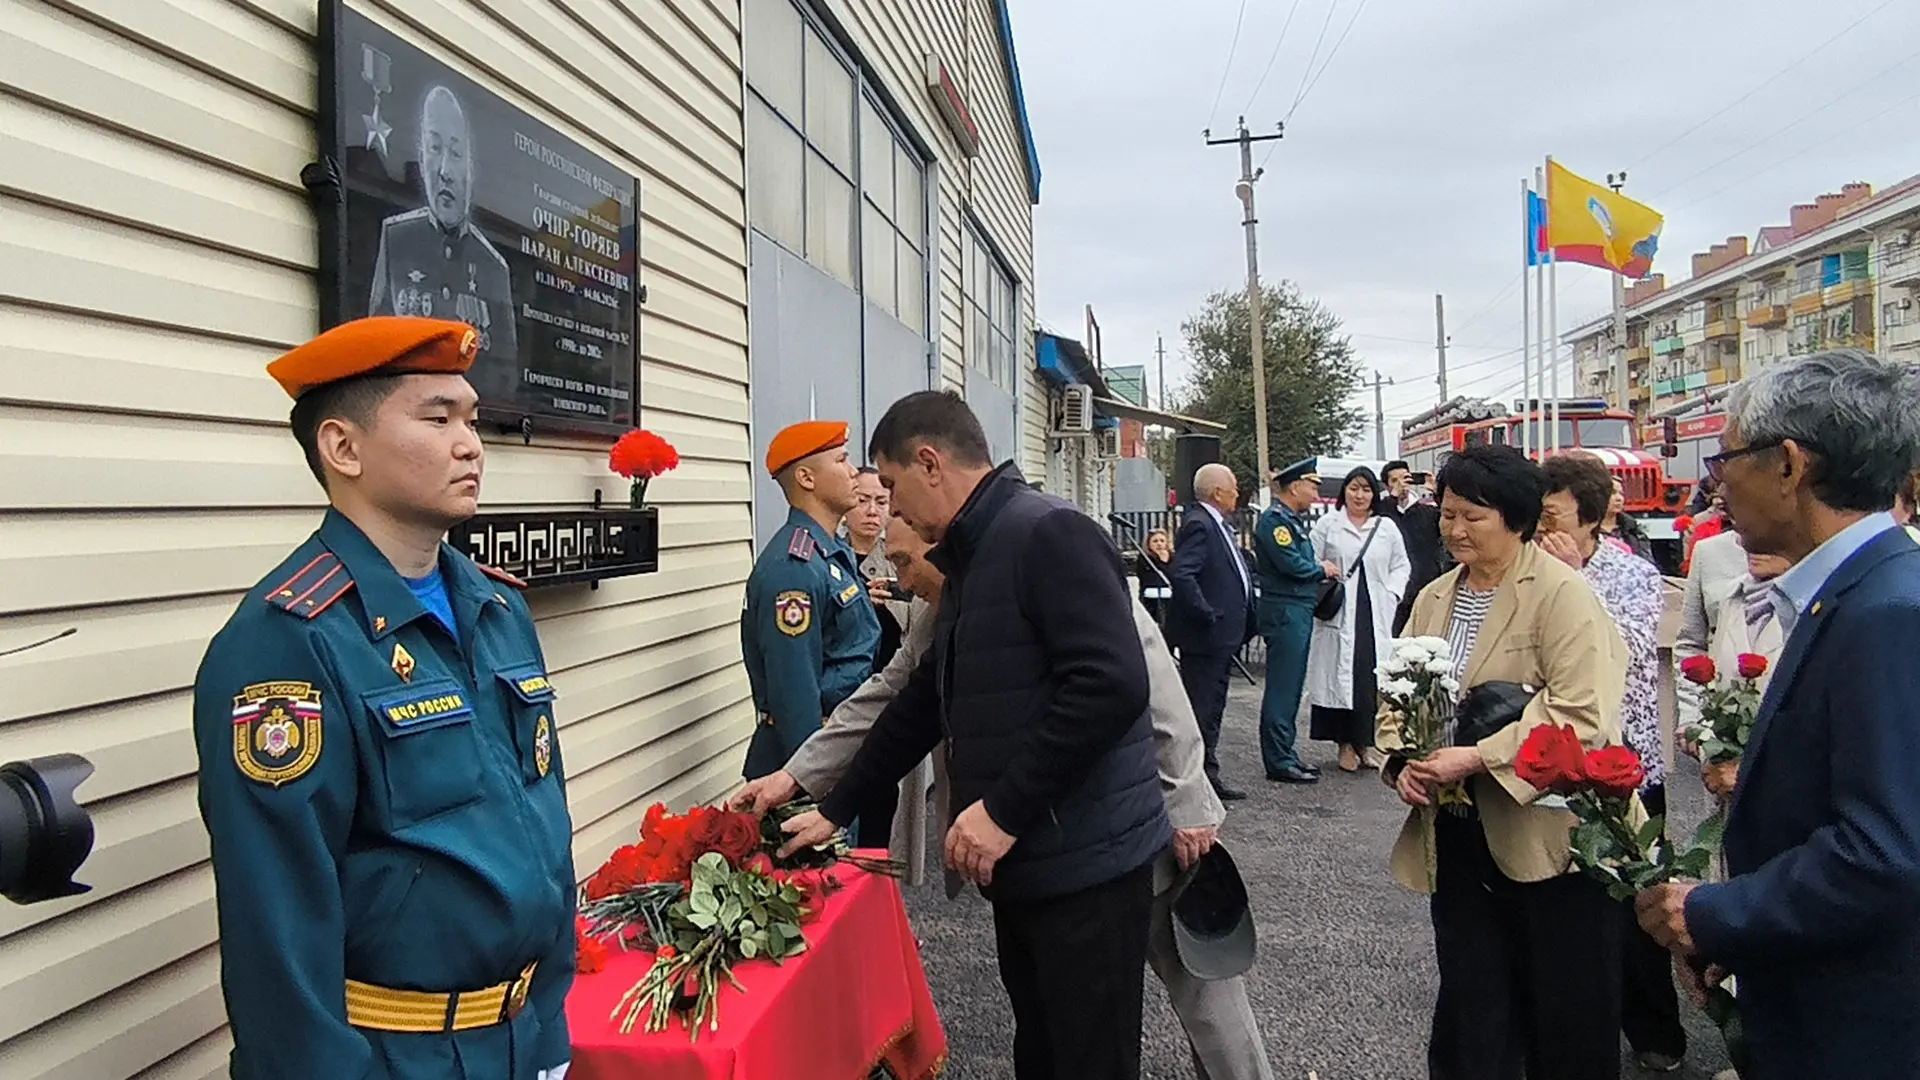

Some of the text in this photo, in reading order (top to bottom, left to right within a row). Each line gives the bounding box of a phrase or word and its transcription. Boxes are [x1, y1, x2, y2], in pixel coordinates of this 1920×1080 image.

[533, 206, 620, 260] ОЧИР-ГОРЯЕВ
[521, 235, 630, 292] НАРАН АЛЕКСЕЕВИЧ
[269, 684, 306, 696] РОССИИ
[388, 694, 465, 722] МЧС РОССИИ
